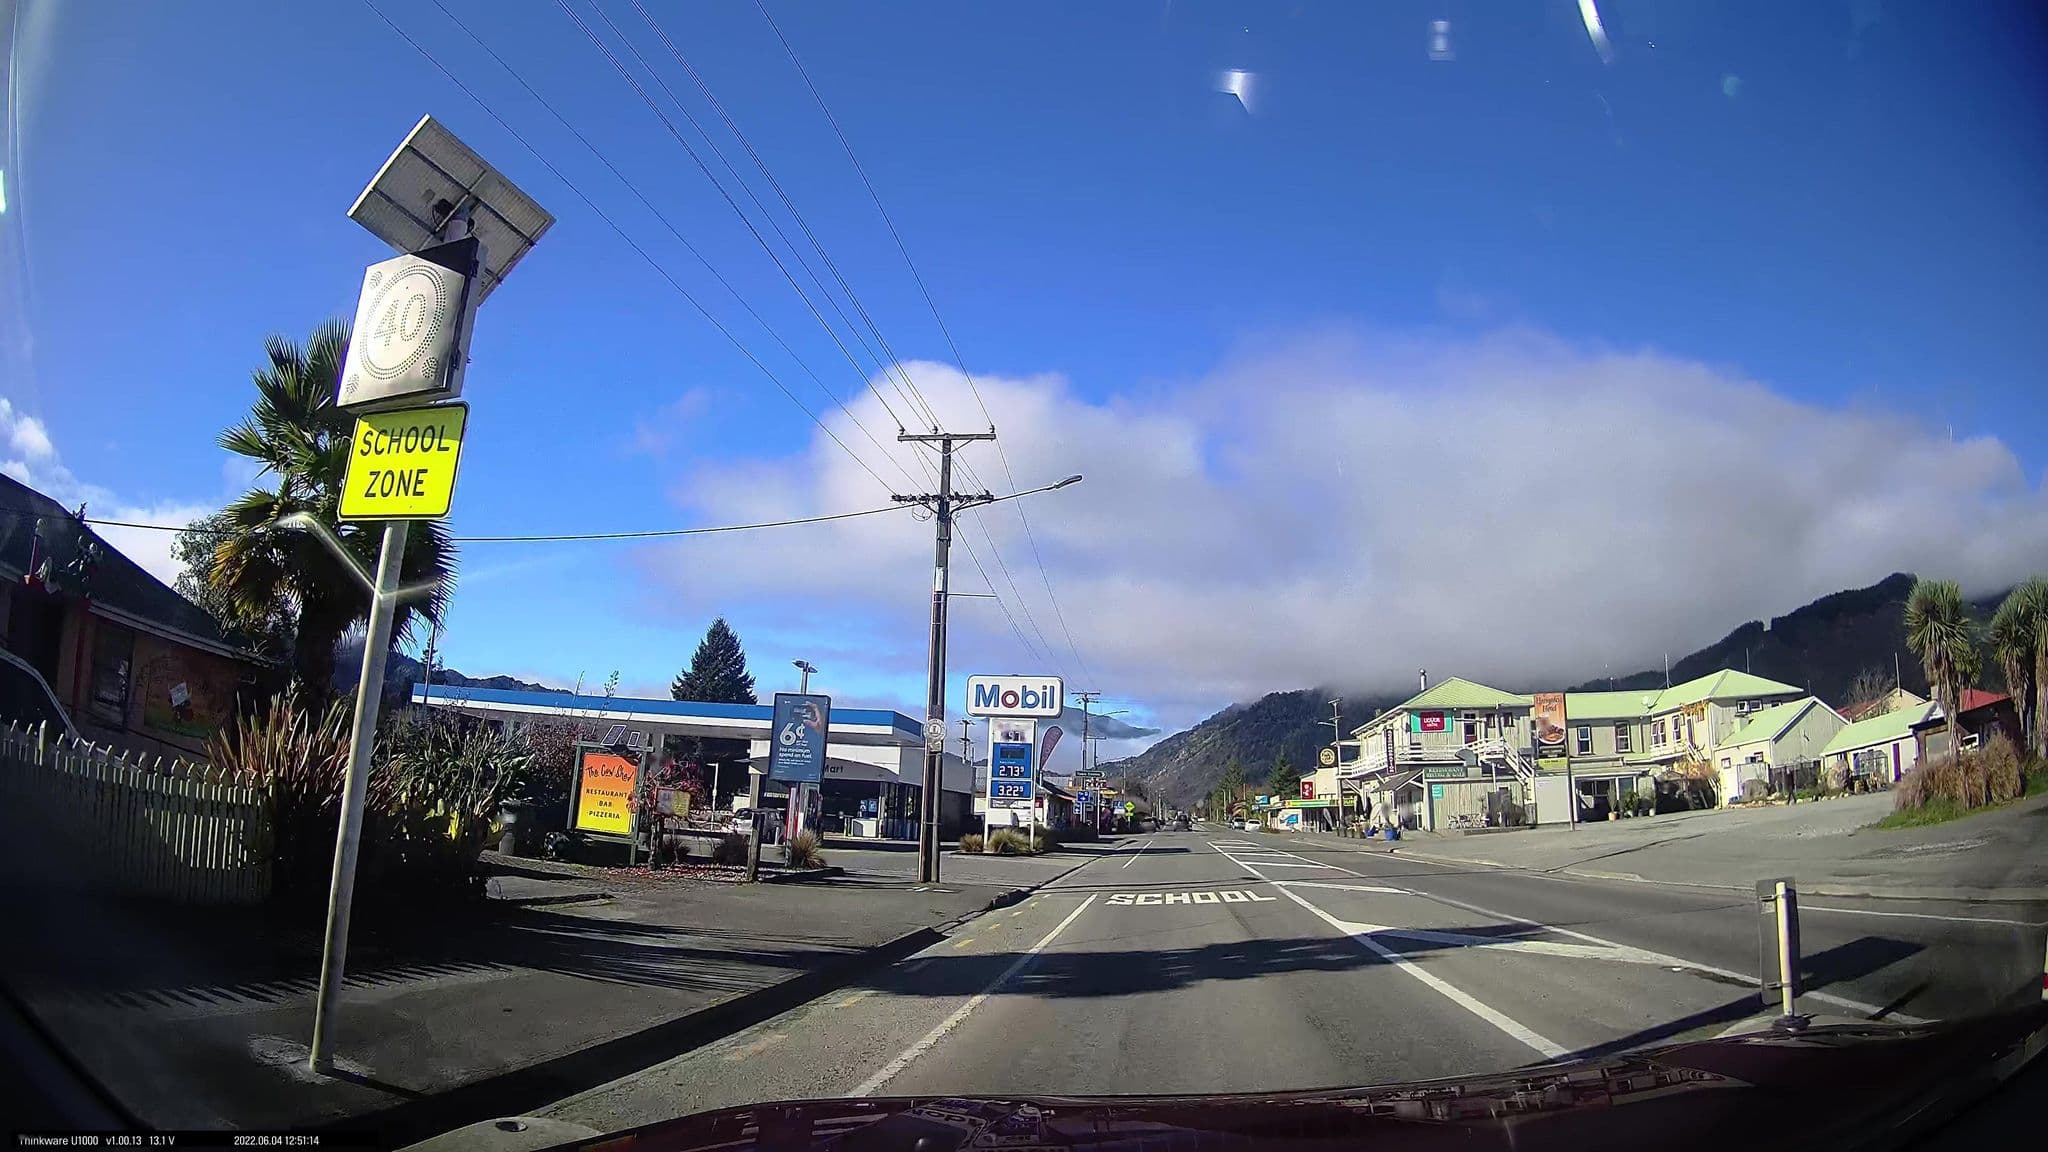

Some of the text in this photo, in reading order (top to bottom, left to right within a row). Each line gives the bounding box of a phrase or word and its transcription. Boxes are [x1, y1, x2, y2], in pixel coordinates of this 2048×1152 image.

[374, 294, 426, 347] 40
[360, 425, 451, 456] SCHOOL
[364, 468, 428, 498] ZONE
[975, 684, 1055, 709] Mobil
[780, 722, 806, 745] 6¢
[585, 766, 599, 778] The
[586, 788, 627, 798] RESTAURANT
[589, 810, 620, 819] PIZZERIA
[1105, 890, 1277, 906] SCHOOL
